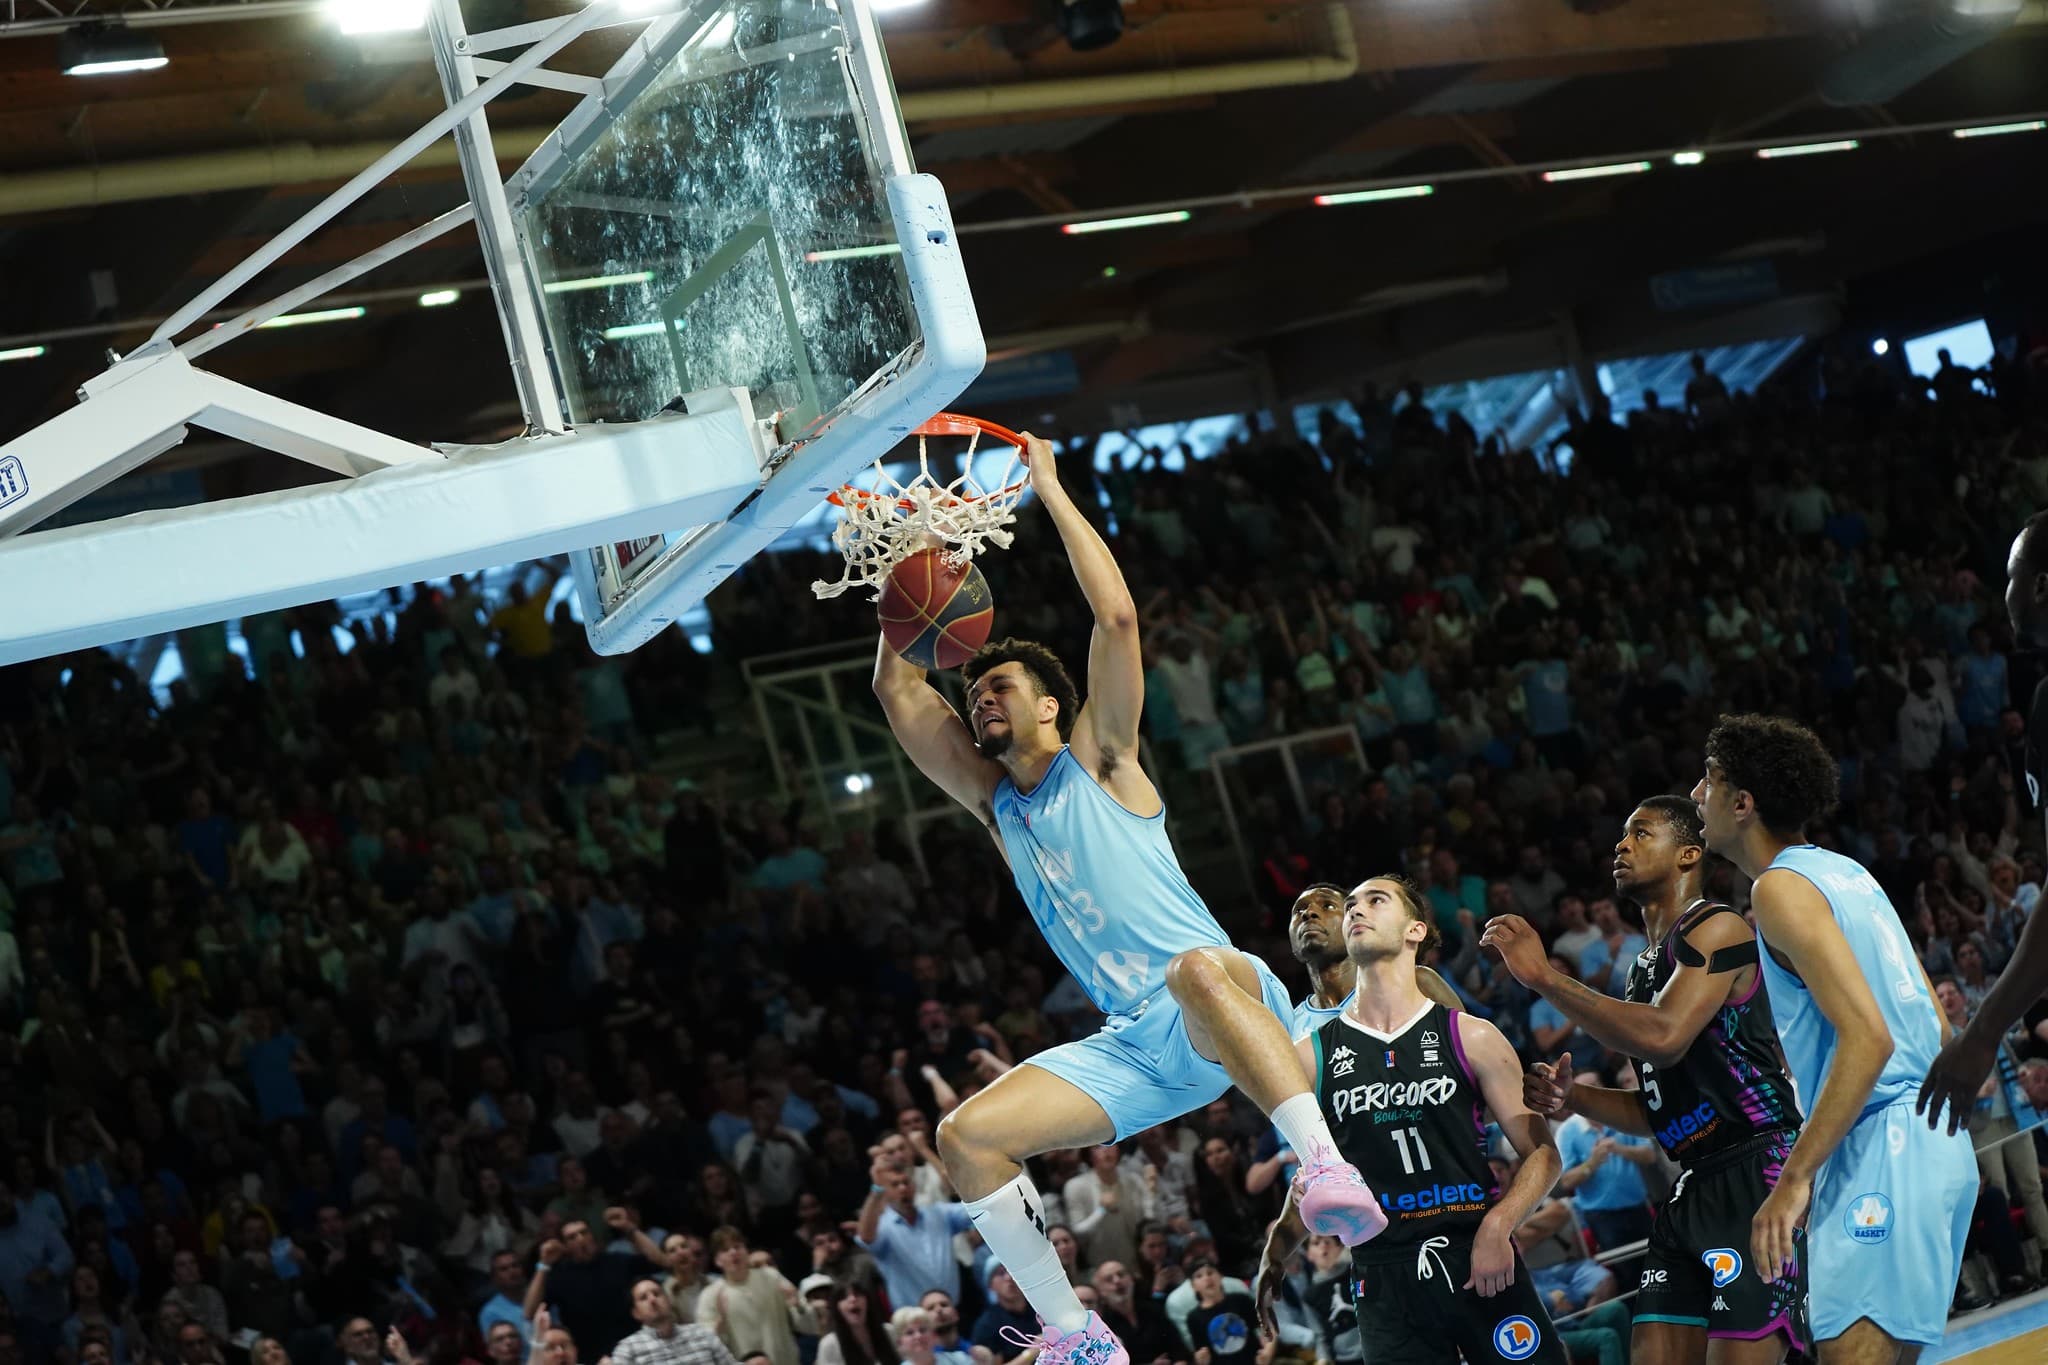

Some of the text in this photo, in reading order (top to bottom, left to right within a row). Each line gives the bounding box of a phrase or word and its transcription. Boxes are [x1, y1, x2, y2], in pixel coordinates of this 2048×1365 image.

[1332, 1074, 1457, 1123] PERIGORD
[1390, 1126, 1432, 1175] 11
[1887, 1125, 1905, 1155] 9
[1381, 1183, 1486, 1211] Leclerc
[1447, 1203, 1486, 1212] TRELISSAC
[1854, 1229, 1886, 1238] BASKET
